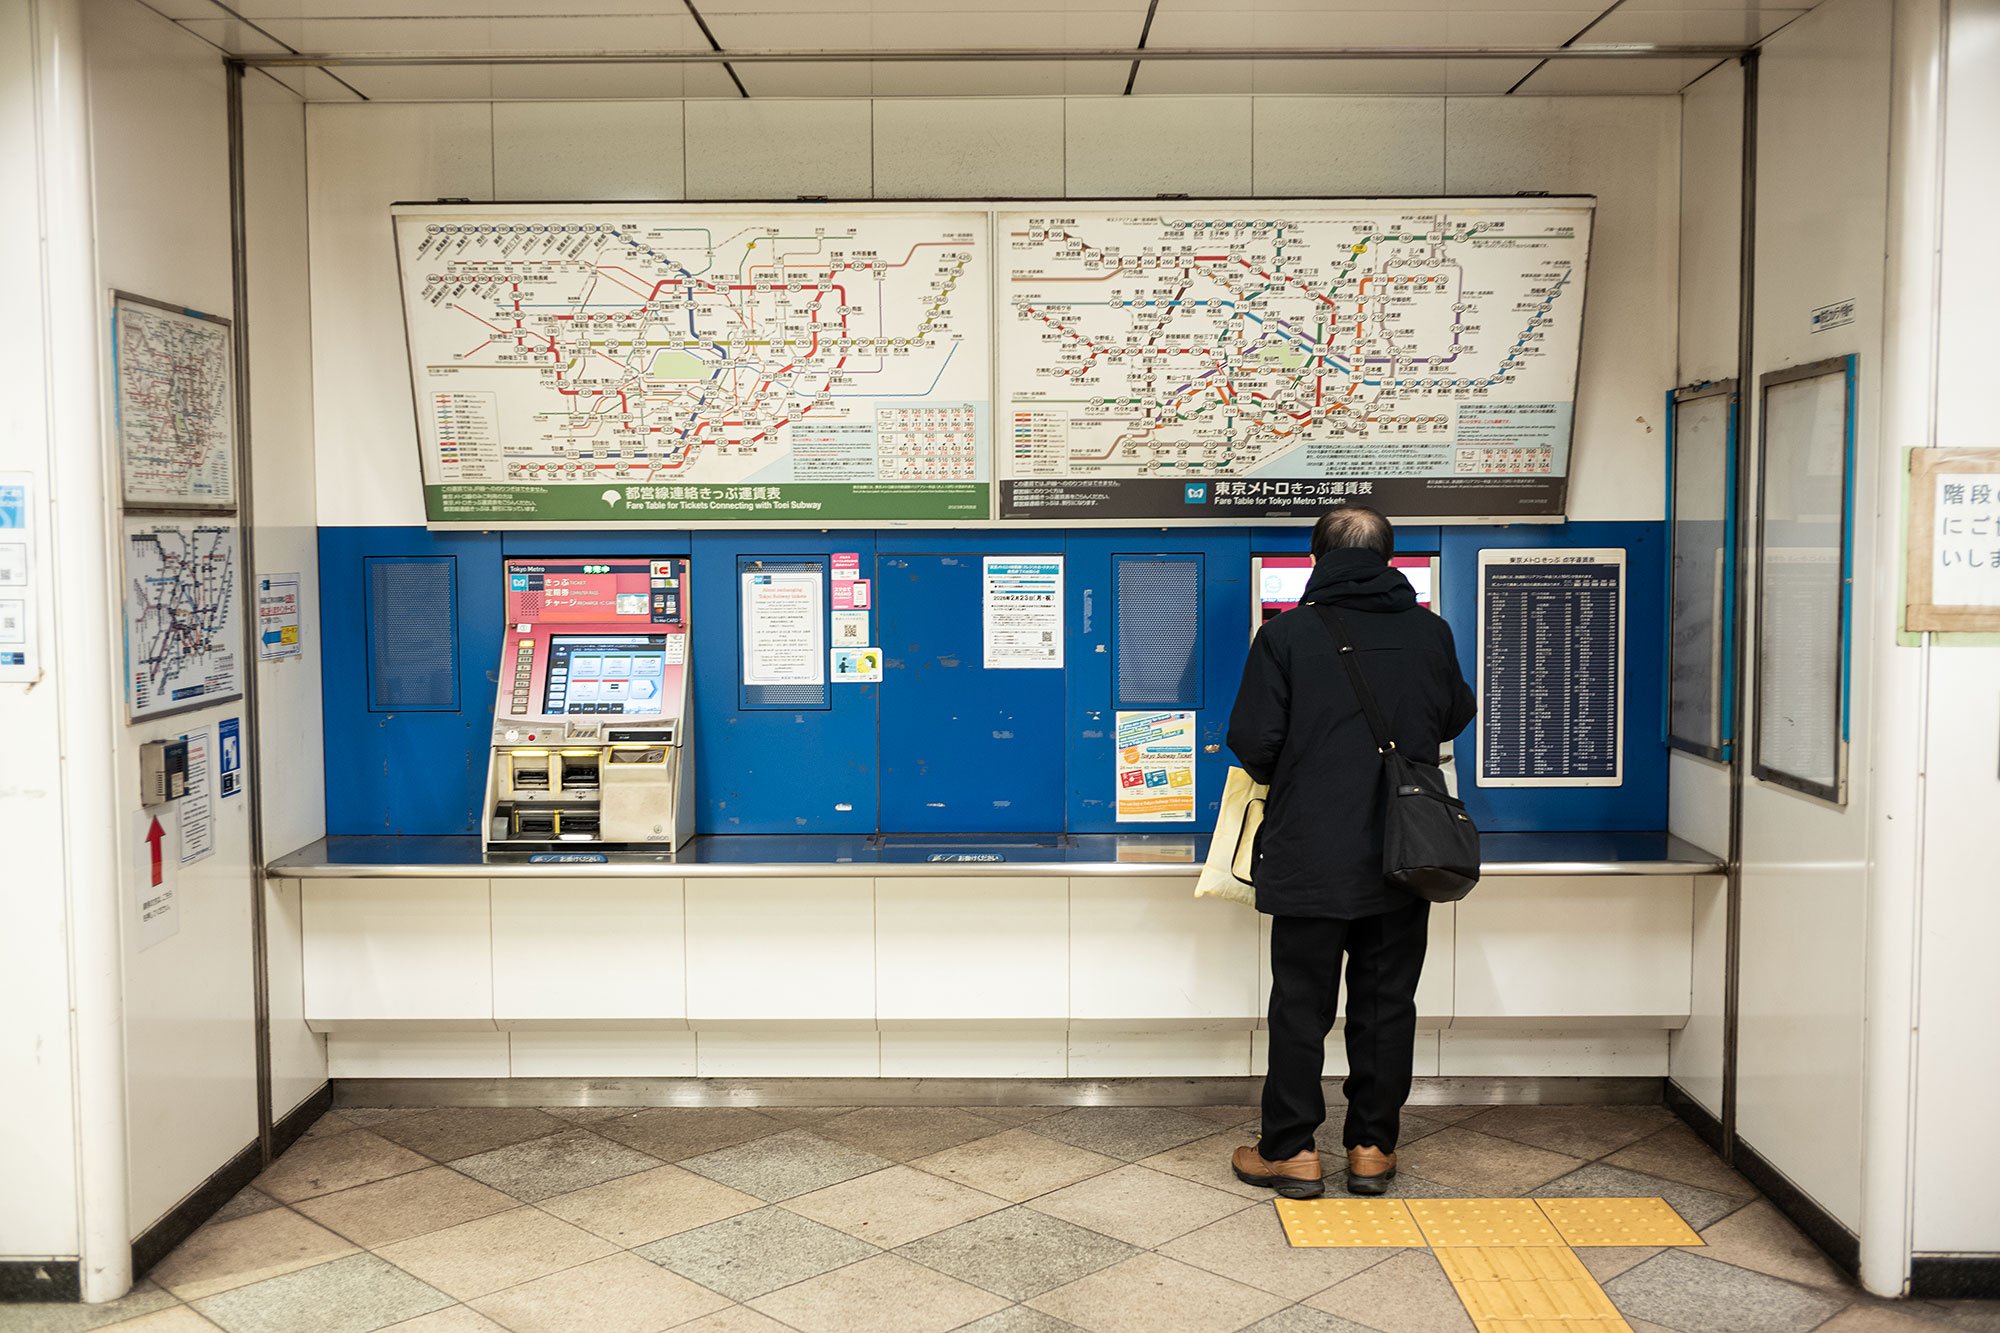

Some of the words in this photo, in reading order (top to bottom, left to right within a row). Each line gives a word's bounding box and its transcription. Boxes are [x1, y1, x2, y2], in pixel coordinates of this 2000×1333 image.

[625, 487, 781, 500] 都営線連絡きっぷ運賃表
[1214, 481, 1373, 495] 東京メトロきっぷ運賃表
[1943, 483, 2000, 505] 階段
[626, 500, 644, 510] Fare
[645, 500, 666, 510] Table
[667, 500, 678, 510] for
[680, 500, 709, 510] Tickets
[709, 500, 754, 511] Connecting
[755, 500, 772, 510] with
[774, 500, 790, 510] Toei
[791, 500, 822, 511] Subway
[1214, 497, 1232, 505] Fare
[1234, 497, 1254, 505] Table
[1255, 497, 1266, 505] for
[1268, 497, 1291, 506] Tokyo
[1293, 497, 1316, 505] Metro
[1318, 497, 1346, 505] Tickets
[1943, 515, 2000, 537] にご
[583, 565, 611, 574] 発売中
